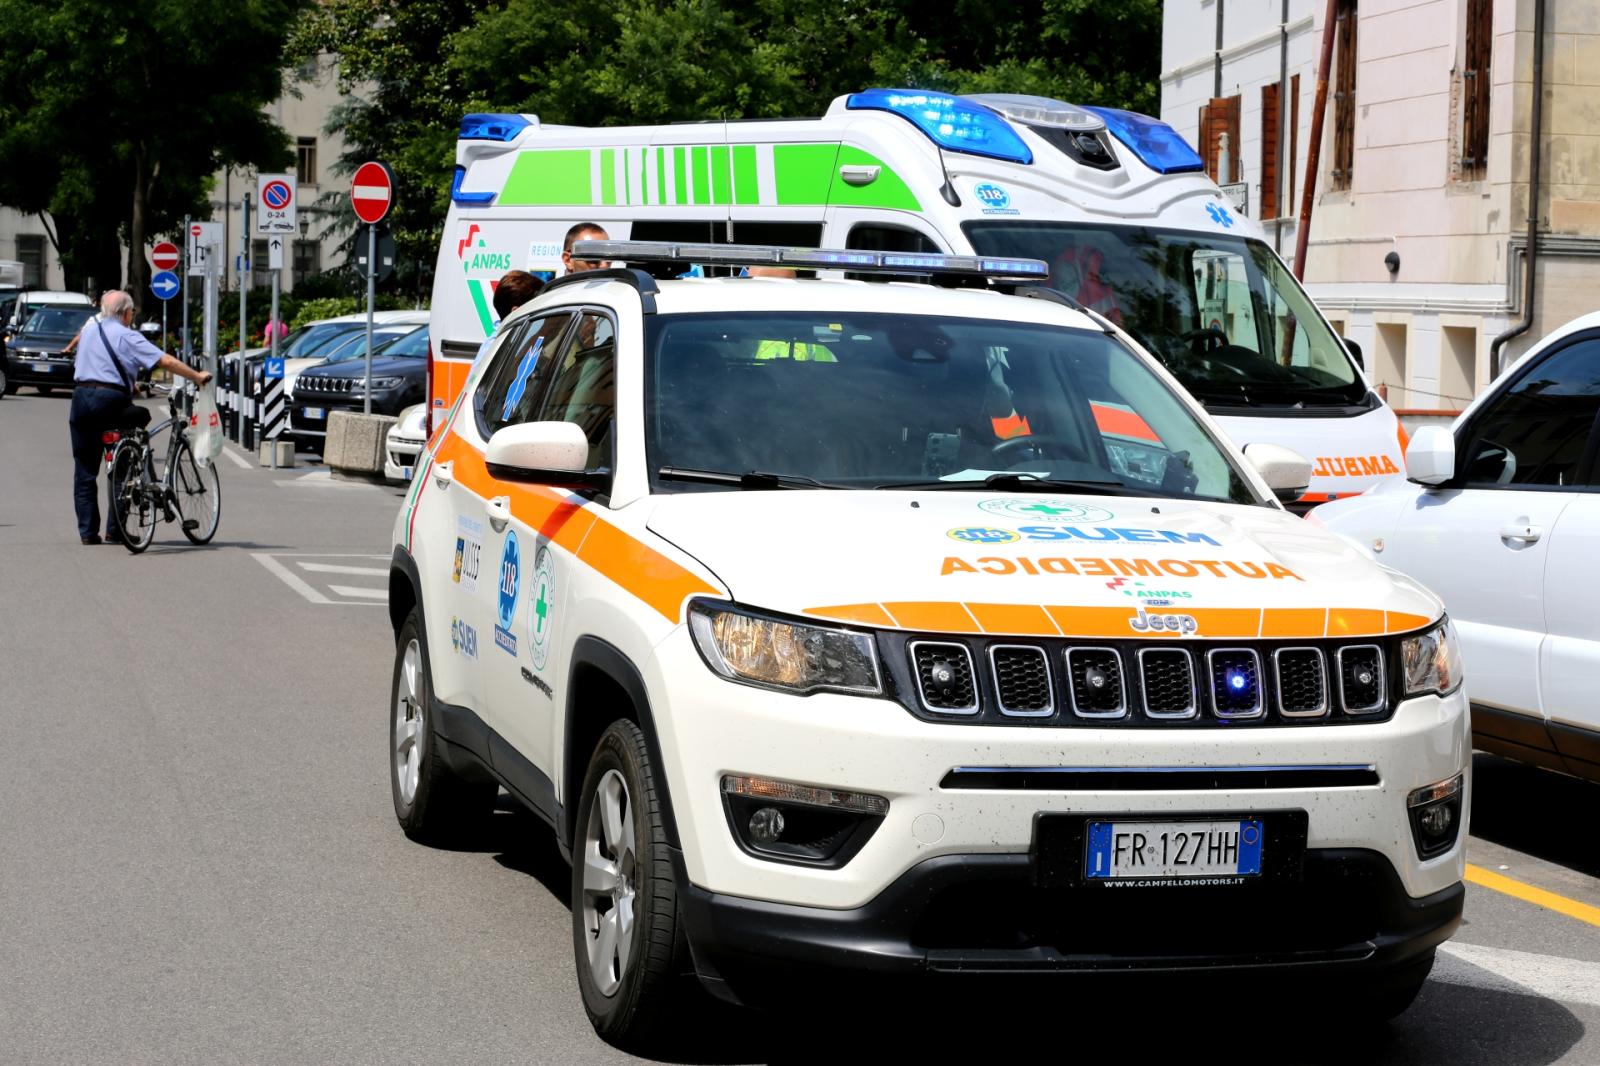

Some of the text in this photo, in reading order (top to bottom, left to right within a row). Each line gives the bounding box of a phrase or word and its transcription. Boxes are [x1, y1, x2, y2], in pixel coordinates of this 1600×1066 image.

[472, 254, 511, 270] ANPAS
[1018, 526, 1223, 547] SUEM
[502, 560, 517, 598] 118
[1137, 590, 1193, 598] ANPAS
[1131, 610, 1196, 634] Jeep
[1114, 831, 1239, 866] FR 127HH
[1104, 878, 1245, 888] WWW.CAMPELLOMOTORS.IT
